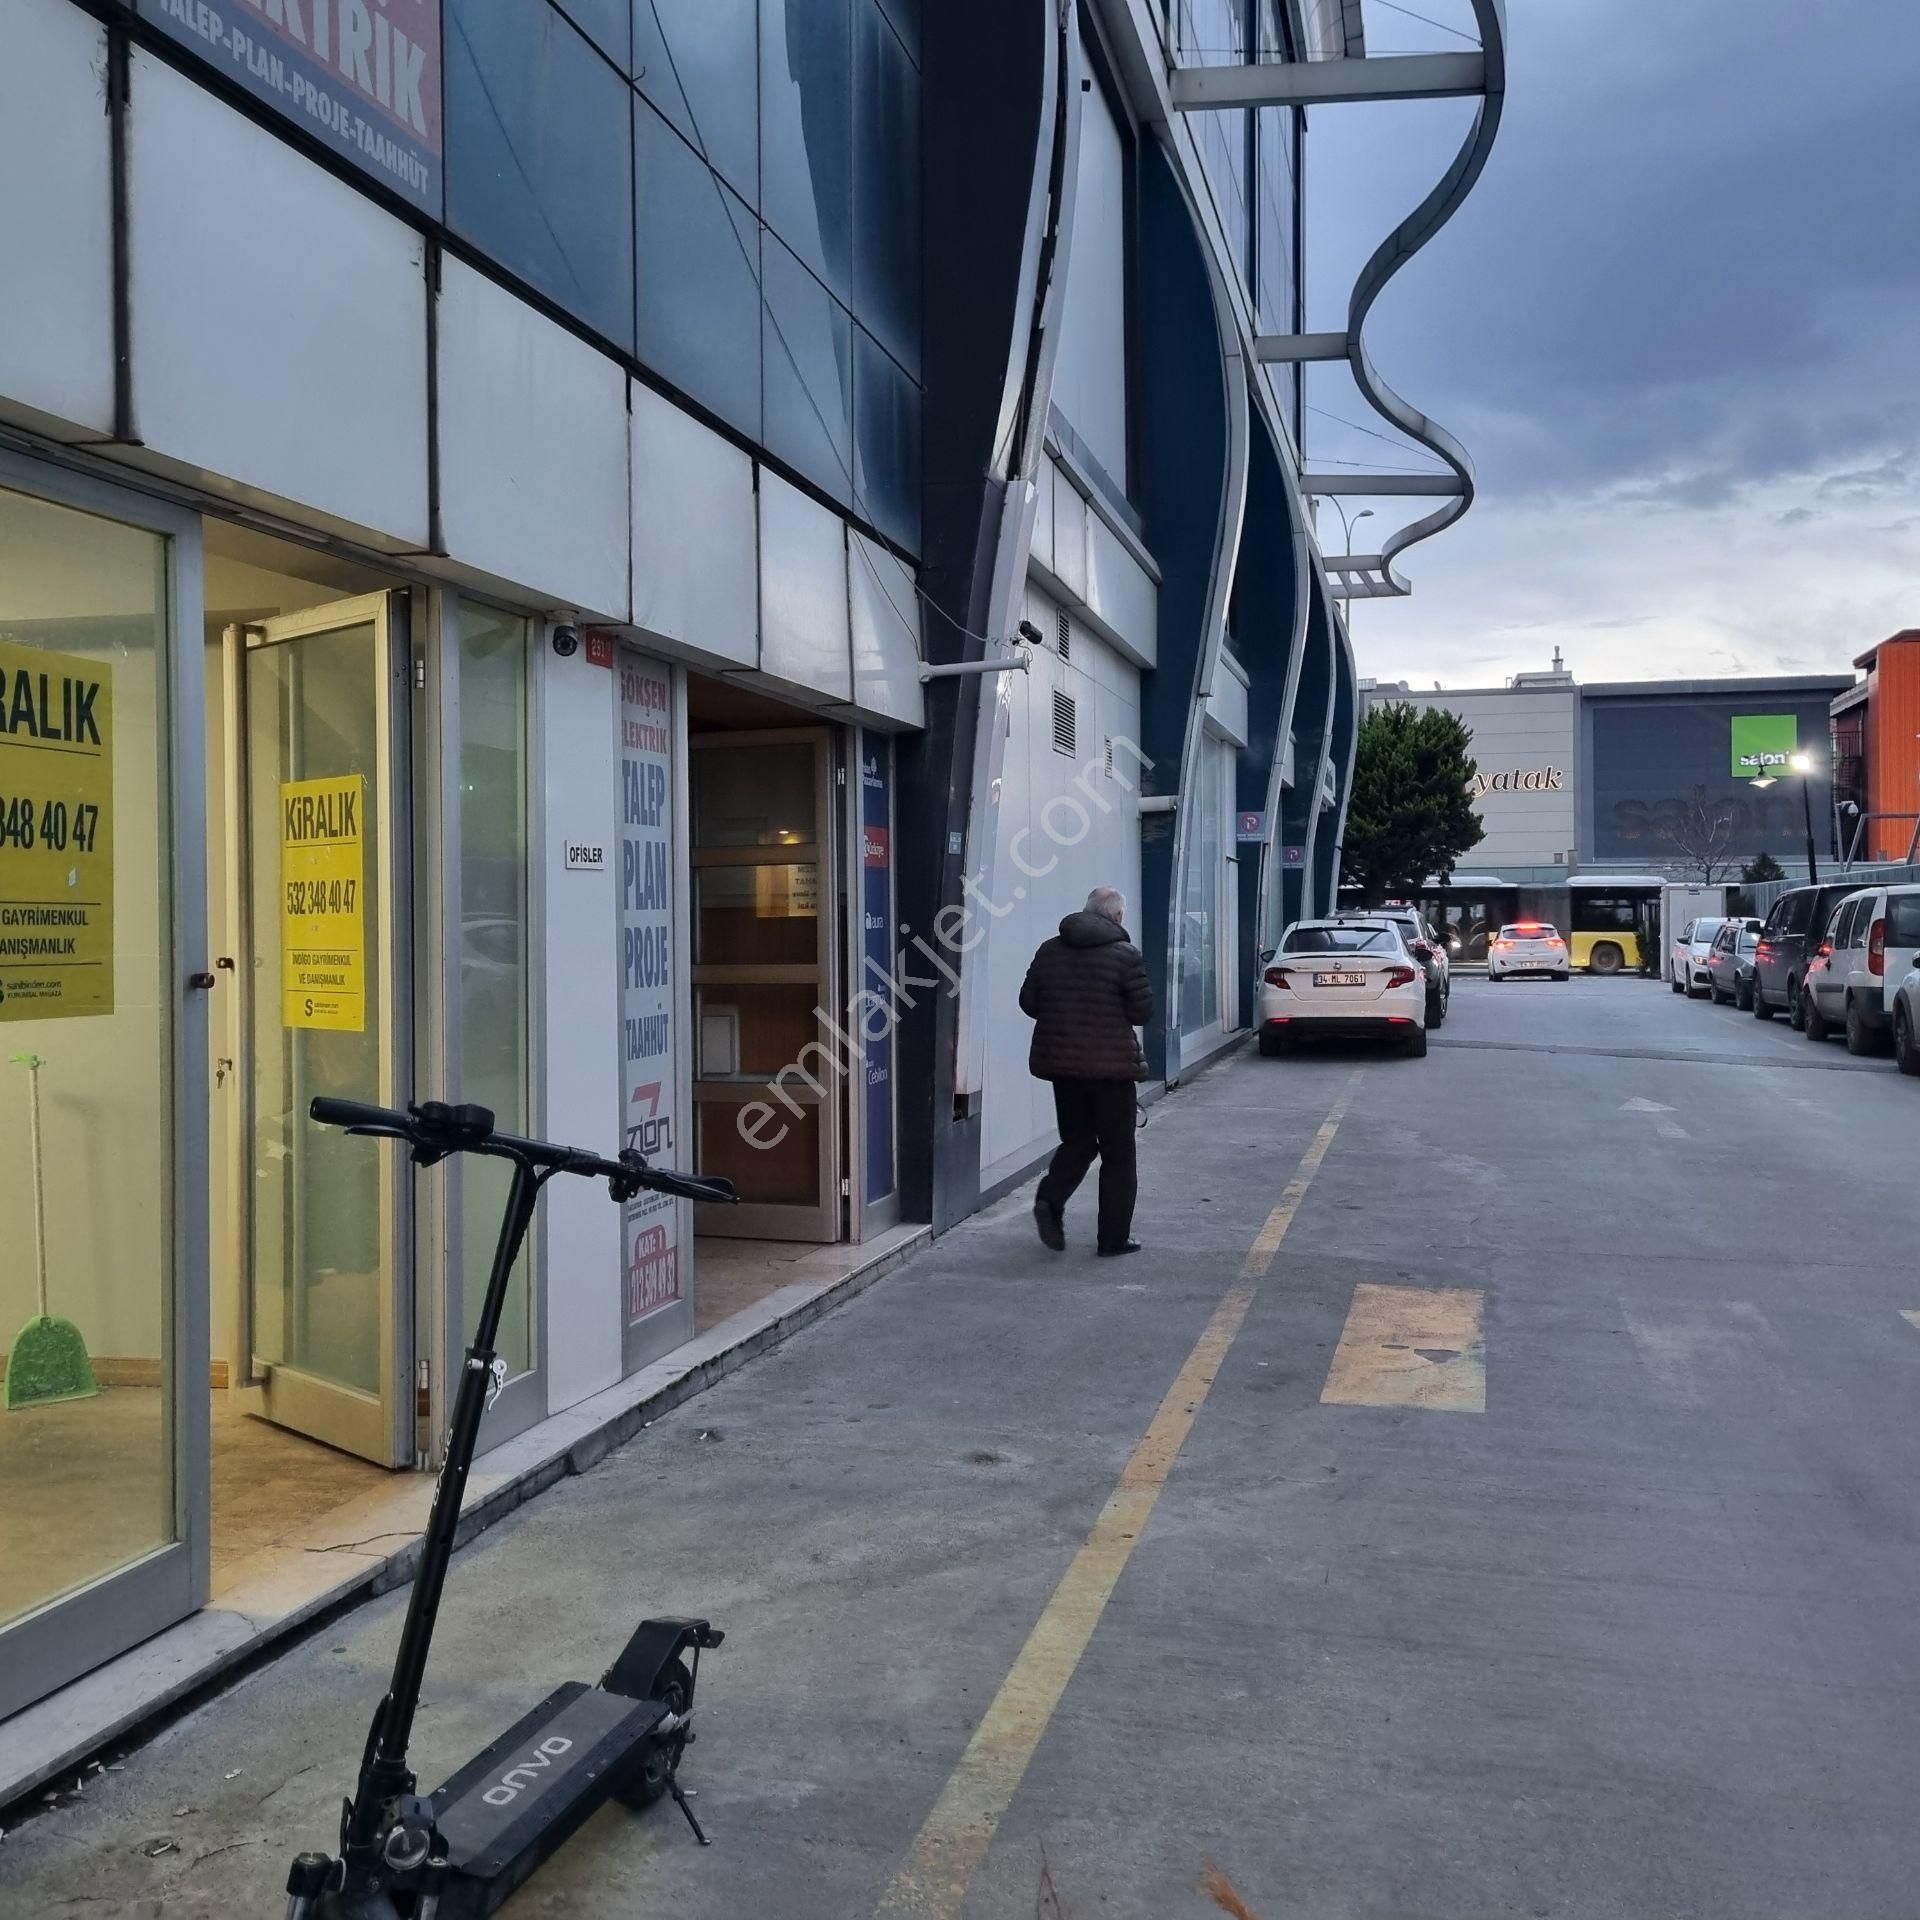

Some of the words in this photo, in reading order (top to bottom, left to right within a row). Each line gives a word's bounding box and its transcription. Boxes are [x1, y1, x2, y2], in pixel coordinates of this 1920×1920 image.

[622, 759, 665, 828] TALEP
[1472, 766, 1563, 798] yatak
[40, 800, 67, 851] 40
[72, 803, 99, 853] 47
[569, 843, 603, 863] OFİSLER
[623, 839, 667, 910] PLAN
[287, 881, 306, 915] 532
[308, 880, 326, 915] 348
[329, 879, 341, 914] 40
[344, 879, 356, 914] 47
[2, 907, 89, 926] GAYRİMENKUL
[624, 926, 668, 989] PROJE
[299, 973, 306, 984] VE
[1318, 975, 1328, 984] 34
[1344, 974, 1363, 983] 7061
[625, 1003, 668, 1061] TAAHHÜT
[638, 1233, 656, 1260] KAT:
[631, 1267, 645, 1314] 212
